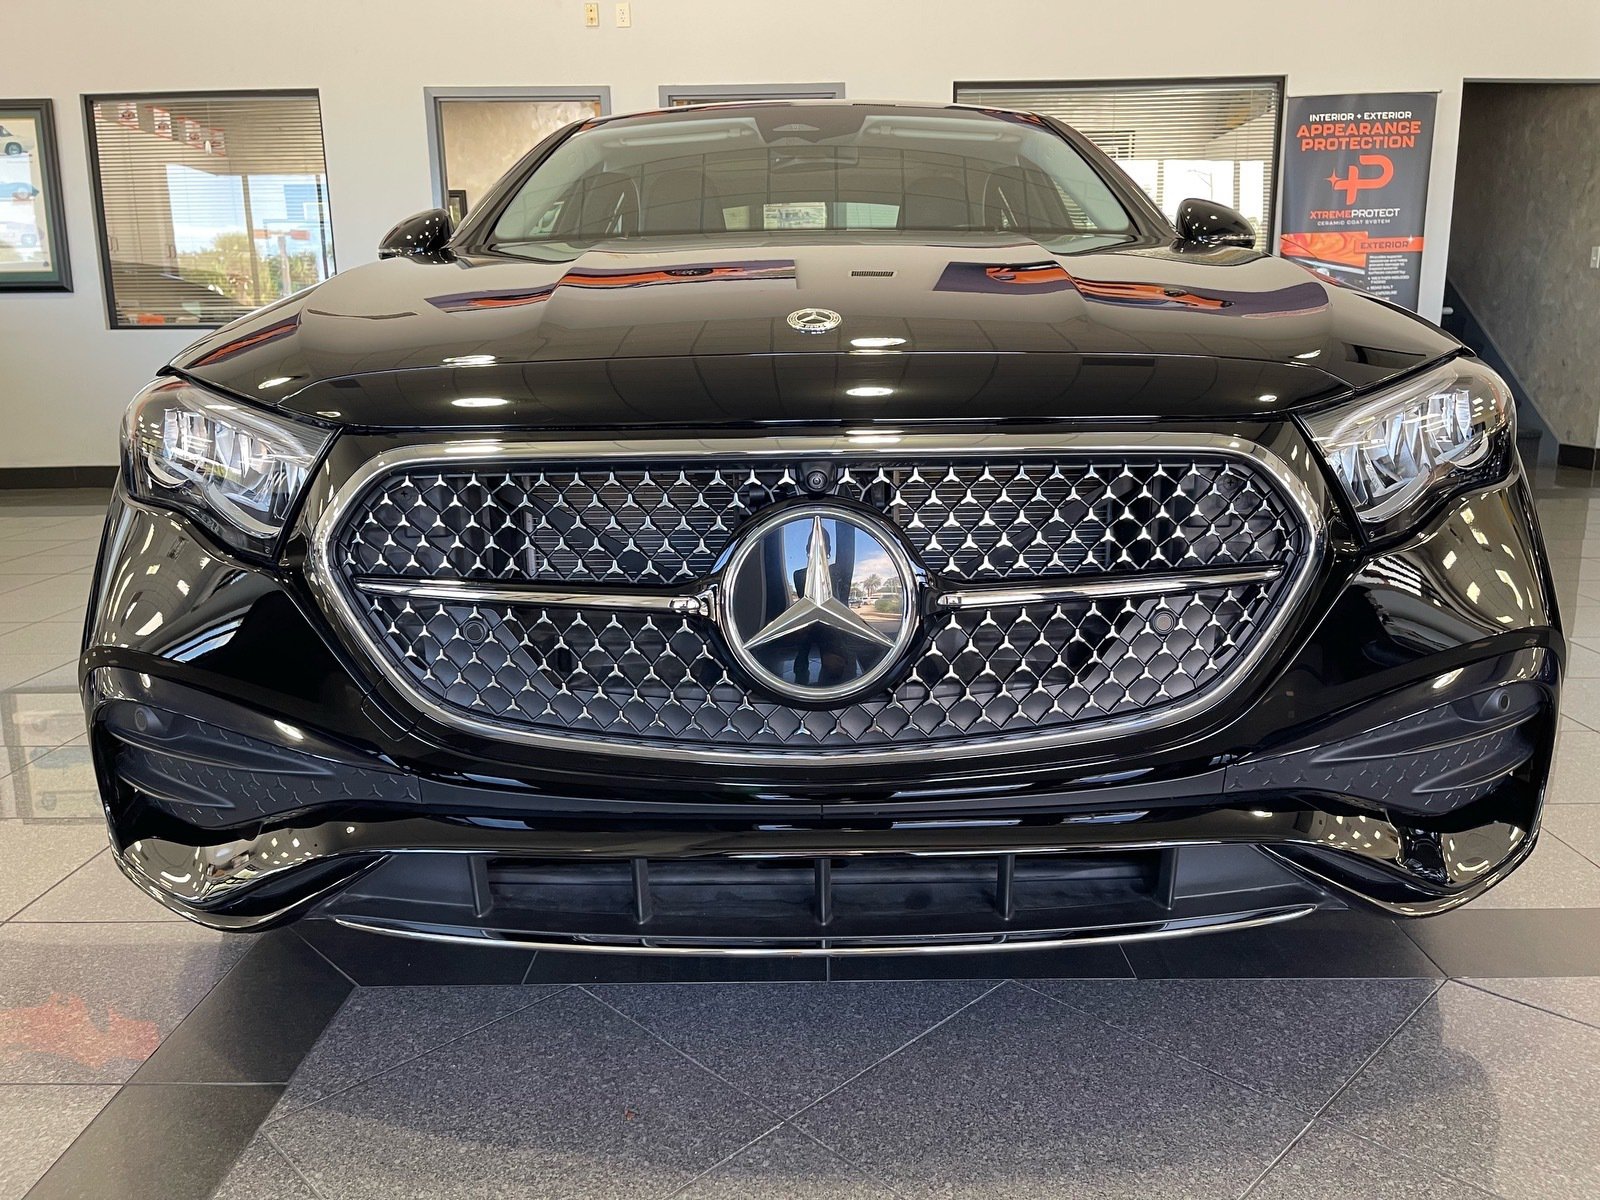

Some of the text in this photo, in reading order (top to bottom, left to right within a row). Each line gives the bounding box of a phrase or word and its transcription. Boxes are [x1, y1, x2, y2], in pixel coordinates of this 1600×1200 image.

[1309, 113, 1355, 122] INTERIOR
[1363, 111, 1412, 120] EXTERIOR
[1296, 121, 1422, 138] APPEARANCE
[1301, 135, 1415, 152] PROTECTION
[1309, 208, 1401, 220] XTREMEPROTECT
[1360, 240, 1409, 250] EXTERIOR
